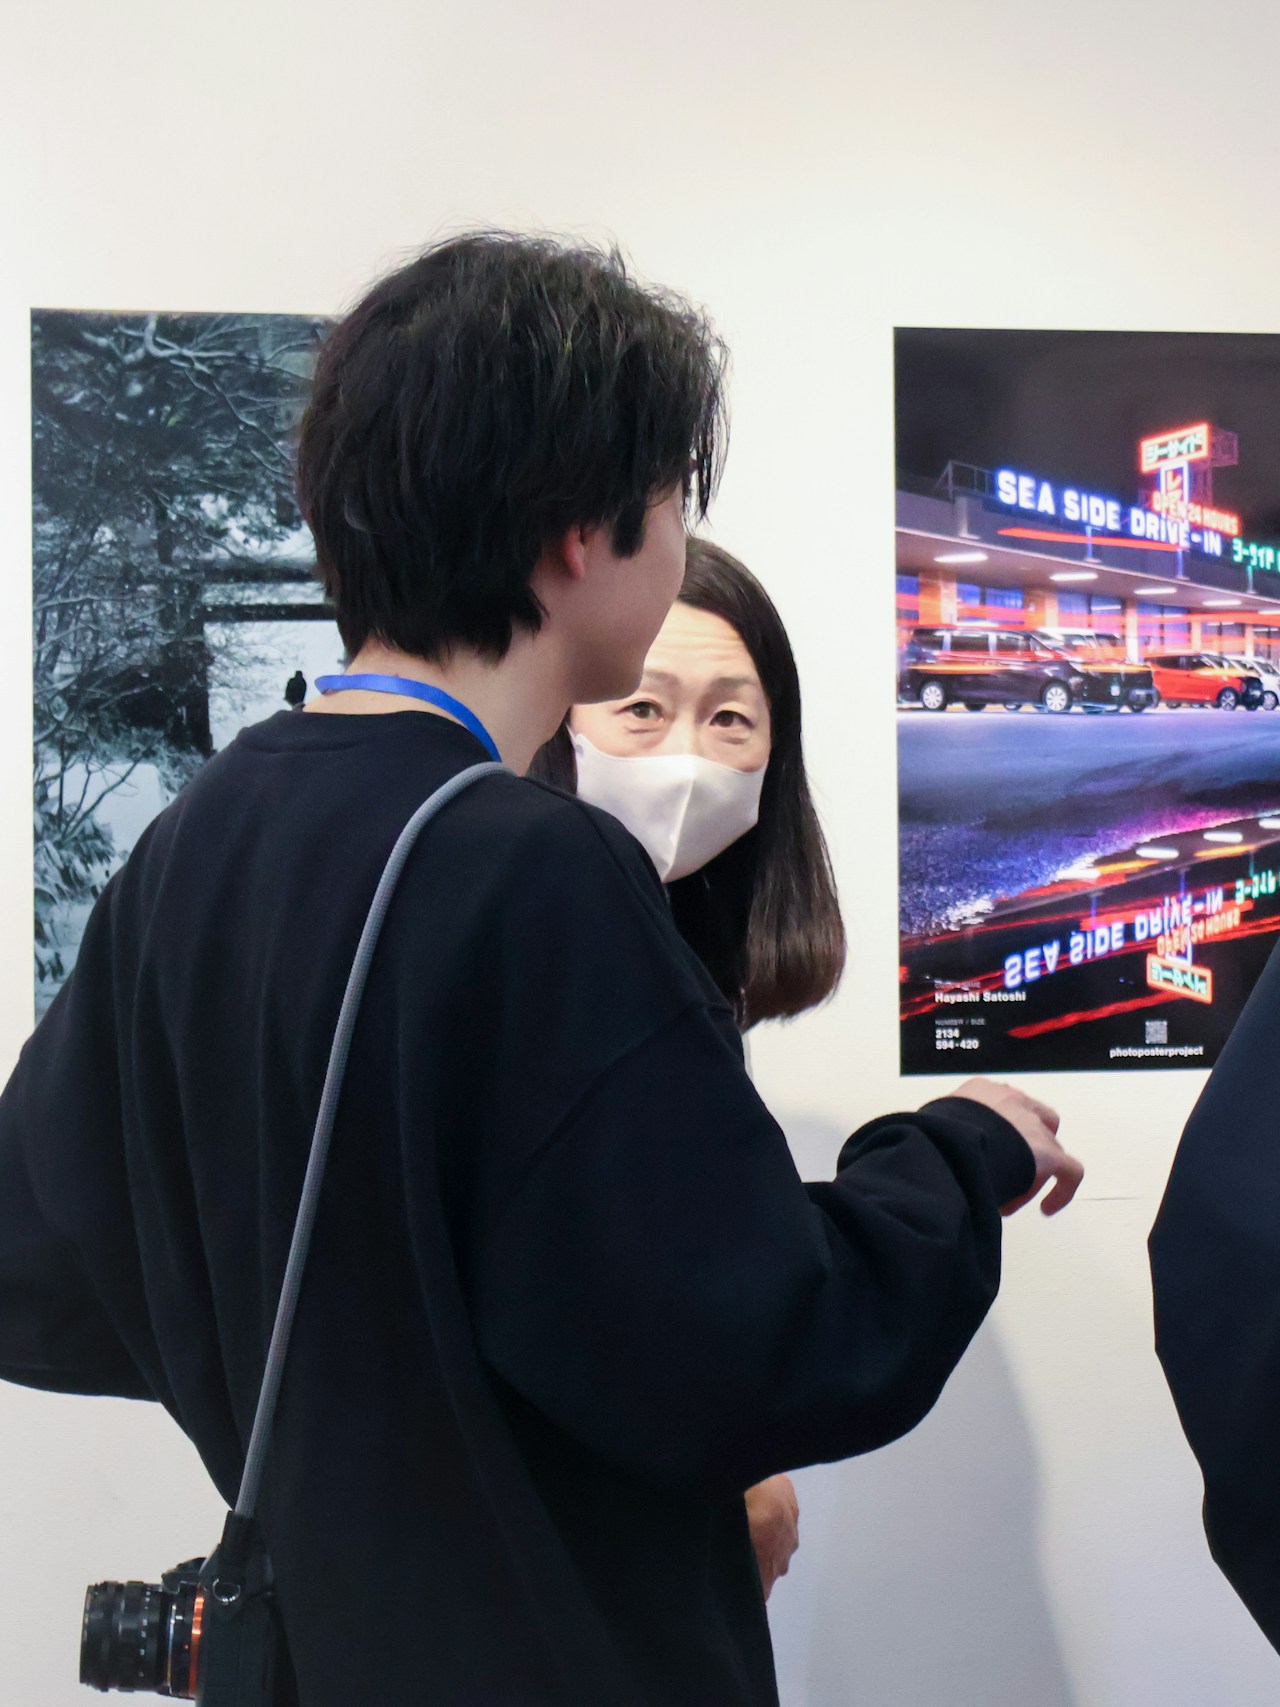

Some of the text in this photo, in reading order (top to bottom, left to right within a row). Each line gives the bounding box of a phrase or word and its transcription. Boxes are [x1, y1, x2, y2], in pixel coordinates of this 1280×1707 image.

[997, 470, 1222, 557] SEA SIDE DRIVE-IN
[1202, 507, 1240, 536] HOURS
[934, 991, 1027, 1004] Hayashi Satoshi
[935, 1028, 960, 1039] 2134
[1109, 1045, 1204, 1059] photoposterproject
